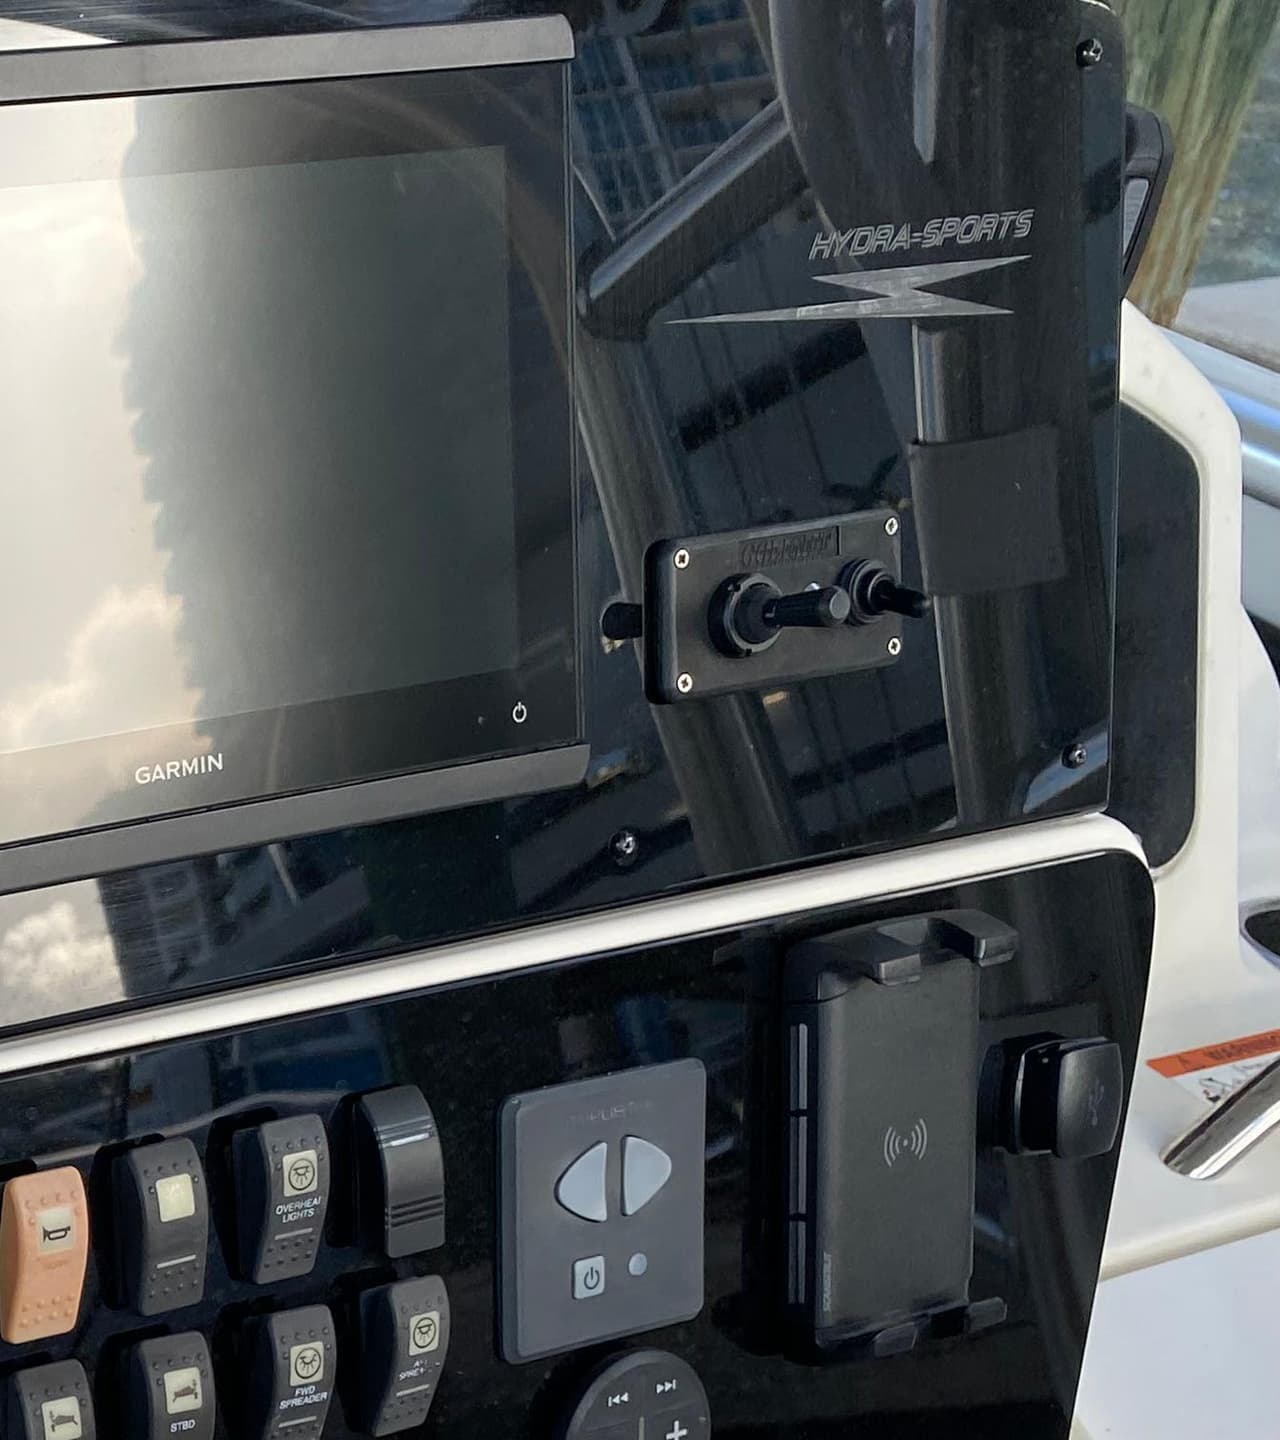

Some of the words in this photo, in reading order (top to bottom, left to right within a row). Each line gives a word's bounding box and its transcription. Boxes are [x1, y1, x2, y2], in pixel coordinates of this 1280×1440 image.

[808, 208, 1035, 260] HYDRA-SPORTS
[135, 753, 223, 784] GARMIN
[275, 1196, 321, 1215] OVERHEA
[282, 1208, 315, 1223] LIGHTS
[279, 1391, 328, 1410] SPREADER
[294, 1385, 316, 1397] FWD
[170, 1418, 197, 1433] STBD
